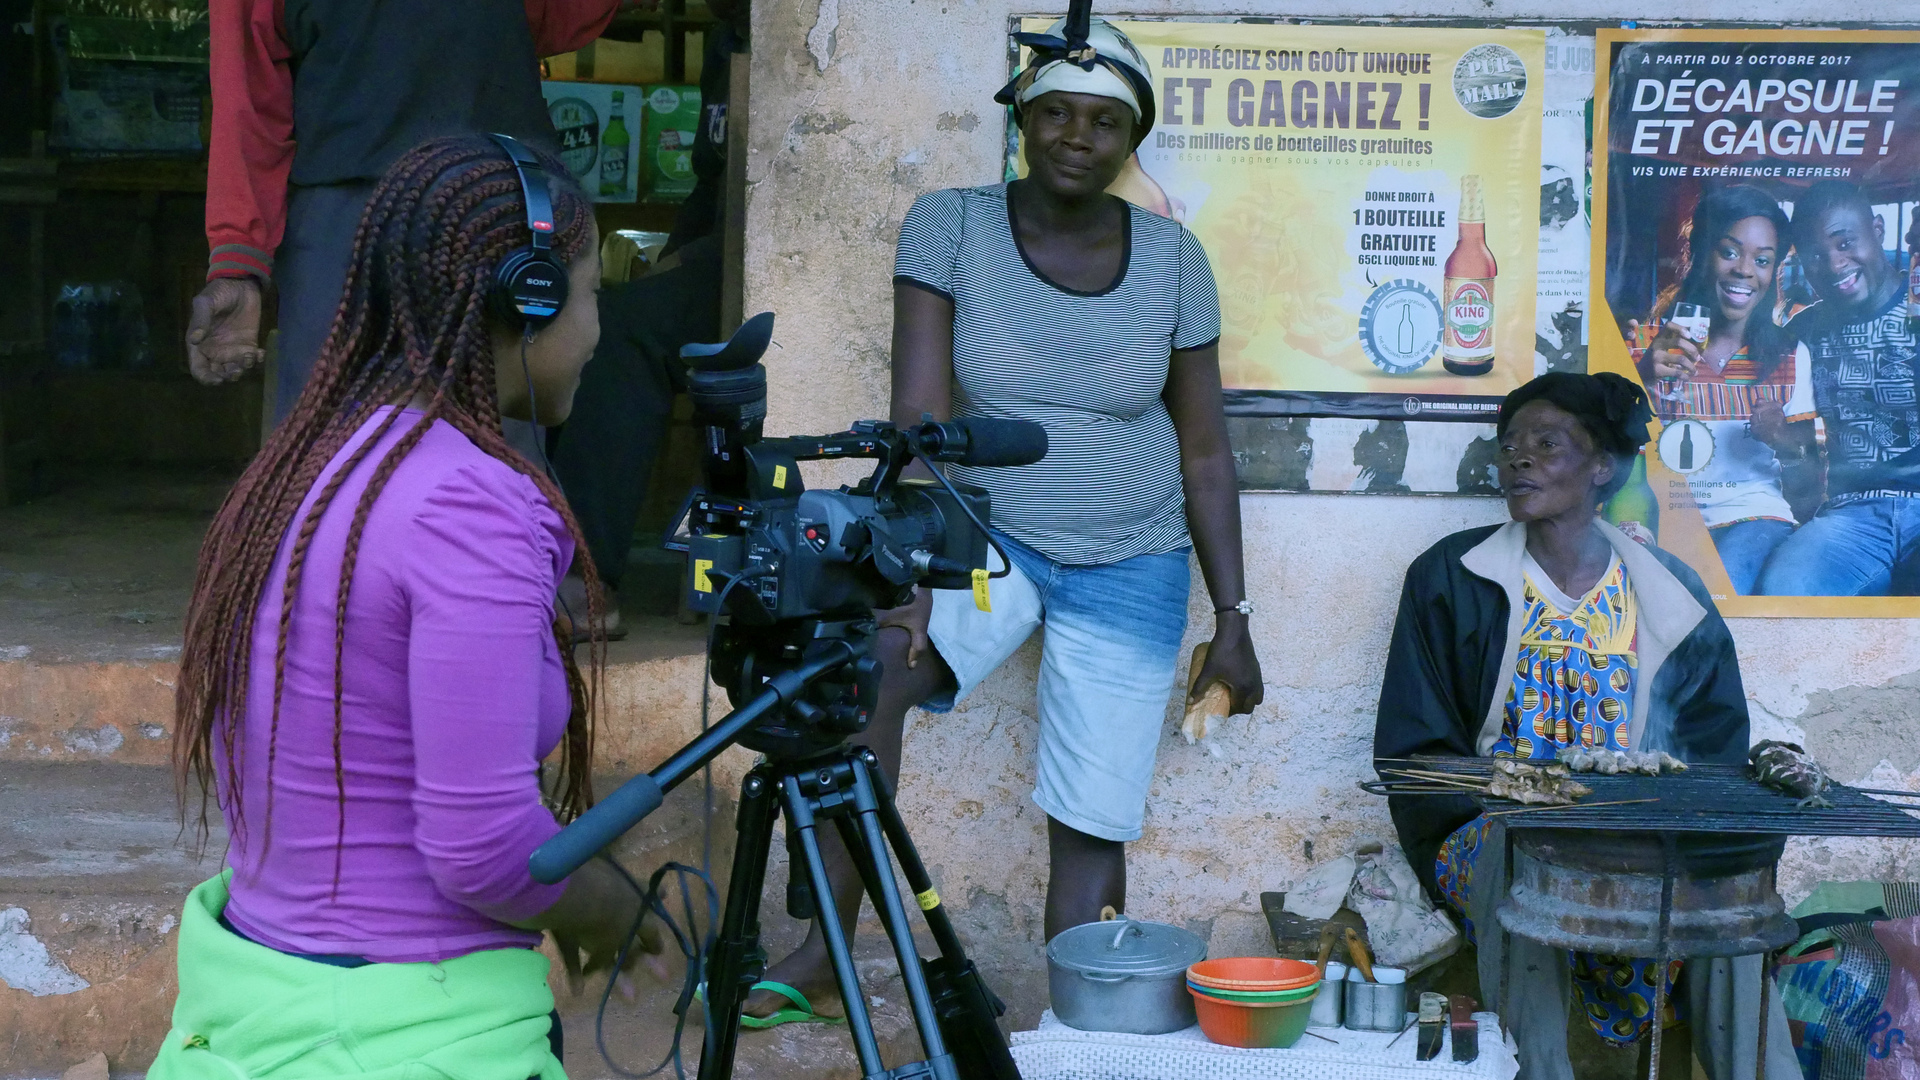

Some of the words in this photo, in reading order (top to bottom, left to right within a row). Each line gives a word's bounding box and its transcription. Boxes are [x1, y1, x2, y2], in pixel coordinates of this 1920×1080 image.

[1162, 45, 1261, 70] APPRÉCIEZ
[1266, 50, 1303, 72] SON
[1308, 48, 1358, 72] GOÛT
[1363, 52, 1432, 76] UNIQUE
[1642, 53, 1650, 64] À
[1656, 55, 1705, 65] PARTIR
[1711, 56, 1730, 65] DU
[1735, 56, 1743, 65] 2
[1748, 56, 1815, 65] OCTOBRE
[1820, 56, 1851, 65] 2017
[1468, 57, 1512, 78] PUR
[1632, 70, 1900, 113] DÉCAPSULE
[1162, 77, 1212, 125] ET
[1227, 78, 1402, 130] GAGNEZ
[1418, 83, 1431, 130] !
[1156, 131, 1185, 148] Des
[1189, 132, 1250, 151] milliers
[1254, 134, 1274, 151] de
[1277, 134, 1357, 153] bouteilles
[1360, 137, 1433, 155] gratuites
[1631, 120, 1694, 154] ET
[1703, 120, 1870, 155] GAGNE
[1878, 120, 1895, 155] !
[1178, 153, 1206, 162] 65cl
[1232, 156, 1278, 165] gagner
[1288, 157, 1318, 165] sous
[1359, 158, 1420, 168] capsules
[1632, 166, 1655, 176] VIS
[1659, 167, 1687, 177] UNE
[1692, 165, 1782, 177] EXPÉRIENCE
[1787, 167, 1851, 177] REFRESH
[1365, 191, 1396, 202] DONNE
[1398, 192, 1426, 203] DROIT
[1428, 191, 1435, 203] À
[1353, 209, 1360, 226] 1
[1364, 209, 1445, 227] BOUTEILLE
[1361, 233, 1436, 252] GRATUITE
[1358, 254, 1382, 265] 65CL
[1384, 256, 1420, 266] LIQUIDE
[1422, 256, 1437, 266] NU.
[526, 278, 553, 286] SONY
[1455, 306, 1484, 318] KING
[1669, 502, 1707, 510] gratuites
